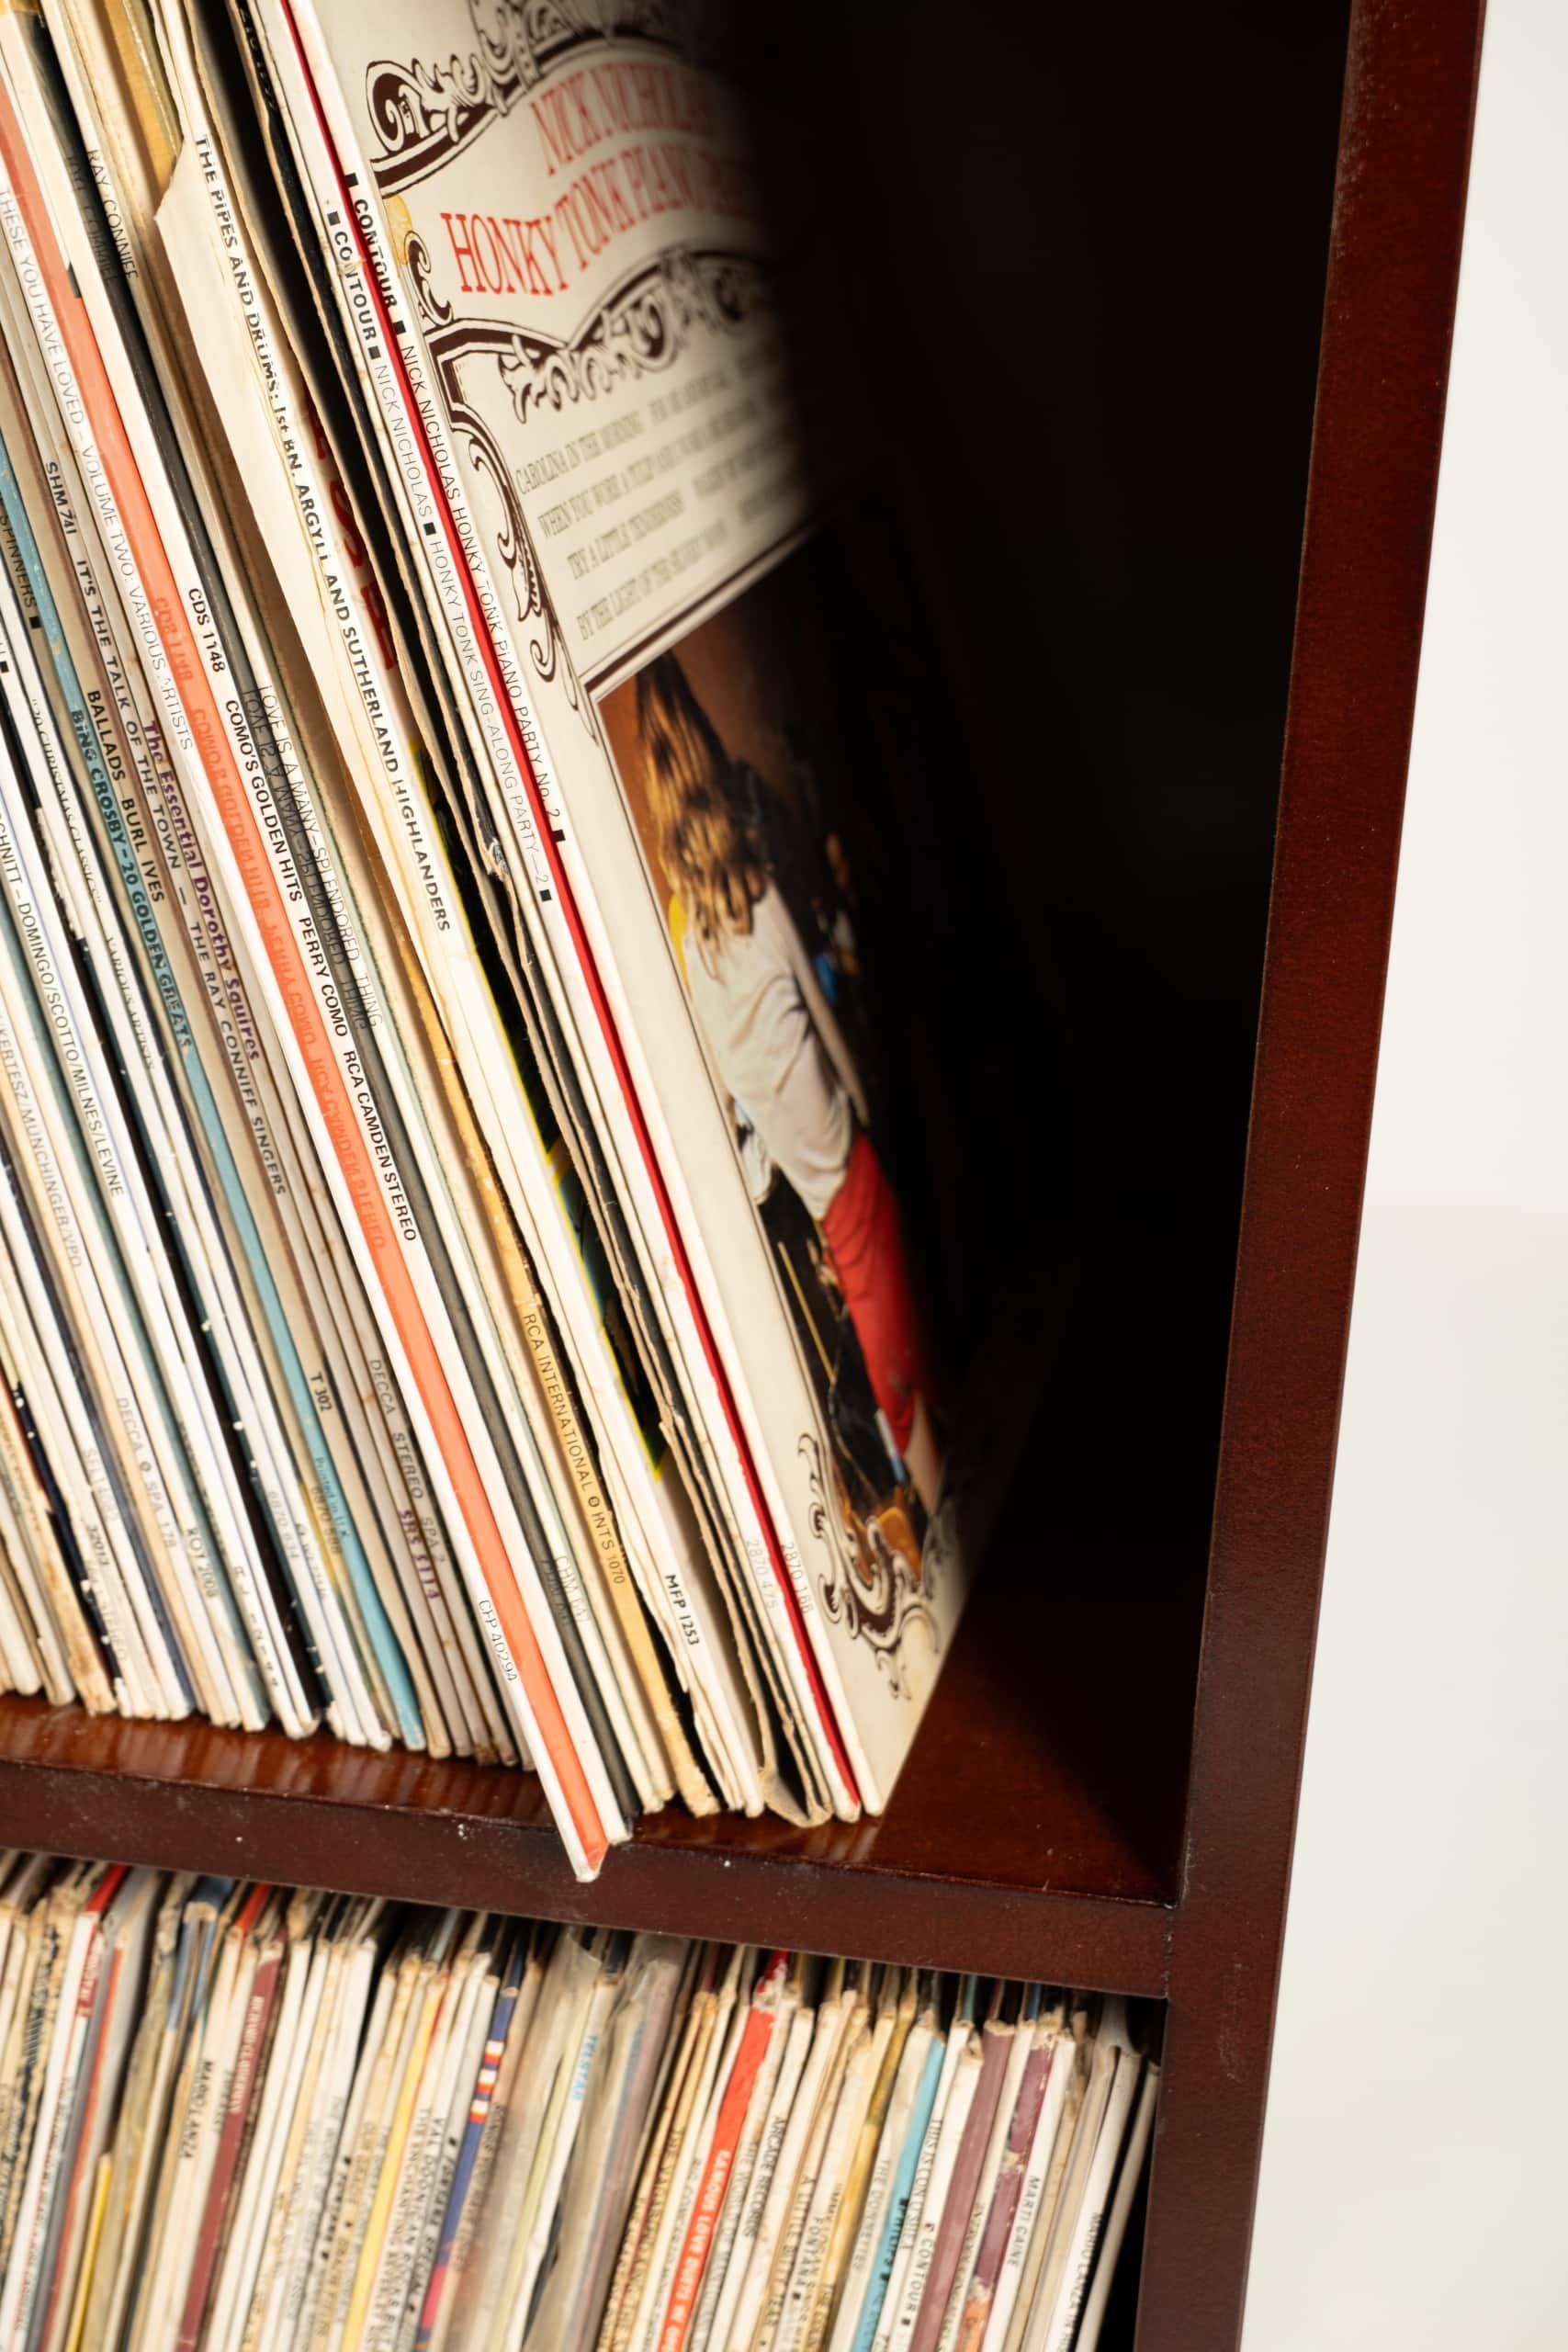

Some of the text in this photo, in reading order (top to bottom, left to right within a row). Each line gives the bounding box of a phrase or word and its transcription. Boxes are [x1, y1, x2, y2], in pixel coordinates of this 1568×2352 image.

[84, 148, 109, 190] RAY
[440, 212, 569, 296] HONKY
[555, 157, 636, 273] TONK
[0, 187, 28, 252] THESE
[17, 254, 45, 300] YOU
[32, 301, 63, 356] HAVE
[51, 359, 85, 426] LOVED
[80, 444, 118, 527] VOLUME
[108, 531, 136, 582] TWO:
[127, 585, 166, 672] VARIOUS
[193, 133, 220, 185] THE
[209, 188, 239, 249] PIPES
[227, 253, 255, 308] AND
[244, 311, 283, 401] DRUMS:
[295, 481, 331, 562] ARGYLL
[323, 571, 351, 624] AND
[341, 625, 400, 774] SUTHERLAND
[390, 778, 451, 933] HIGHLANDERS
[332, 230, 378, 341] CONTOUR
[372, 364, 400, 413] NICK
[389, 417, 433, 518] NICHOLAS
[427, 540, 461, 611] HONKY
[449, 614, 479, 667] TONK
[468, 668, 518, 790] SING-ALONG
[353, 197, 560, 820] CONTOUR NICK NICHOLAS HONKY TONK PIANO PARTY No. 2
[256, 684, 285, 731] LOVE
[274, 737, 293, 755] IS
[86, 690, 165, 904] BALLADS BURL IVES
[281, 759, 299, 776] A
[44, 460, 286, 1197] SHM 741 IT'S THE TALK OF THE TOWN THE RAY CONNIFF SINGERS
[70, 707, 98, 763] BING
[88, 766, 125, 847] CROSBY
[120, 861, 138, 887] 20
[130, 889, 166, 971] GOLDEN
[142, 720, 262, 1062] The Essential Dorothy Squires
[186, 587, 417, 1243] CDS 1148 COMO'S GOLDEN HITS PERRY COMO RCA CAMDEN STEREO
[353, 974, 384, 1028] THING
[17, 901, 123, 1197] DOMINGO/SCOTTO/MILNES/LEVINE
[309, 1372, 332, 1412] T 302
[522, 1312, 547, 1351] RCA
[536, 1354, 595, 1492] INTERNATIONAL
[367, 1358, 397, 1416] DECCA
[390, 1430, 425, 1501] STEREO
[419, 1515, 441, 1550] SPA
[780, 1541, 805, 1582] 2870
[477, 1598, 518, 1683] CFP 40294
[663, 1572, 700, 1646] MFP 1253
[570, 2033, 598, 2101] TELSTAR
[701, 2149, 731, 2211] FAMOUS
[1006, 2176, 1040, 2267] MARTI CAINE
[688, 2214, 712, 2254] LOVE
[794, 2216, 821, 2288] FONTANA
[904, 2238, 933, 2312] CONTOUR
